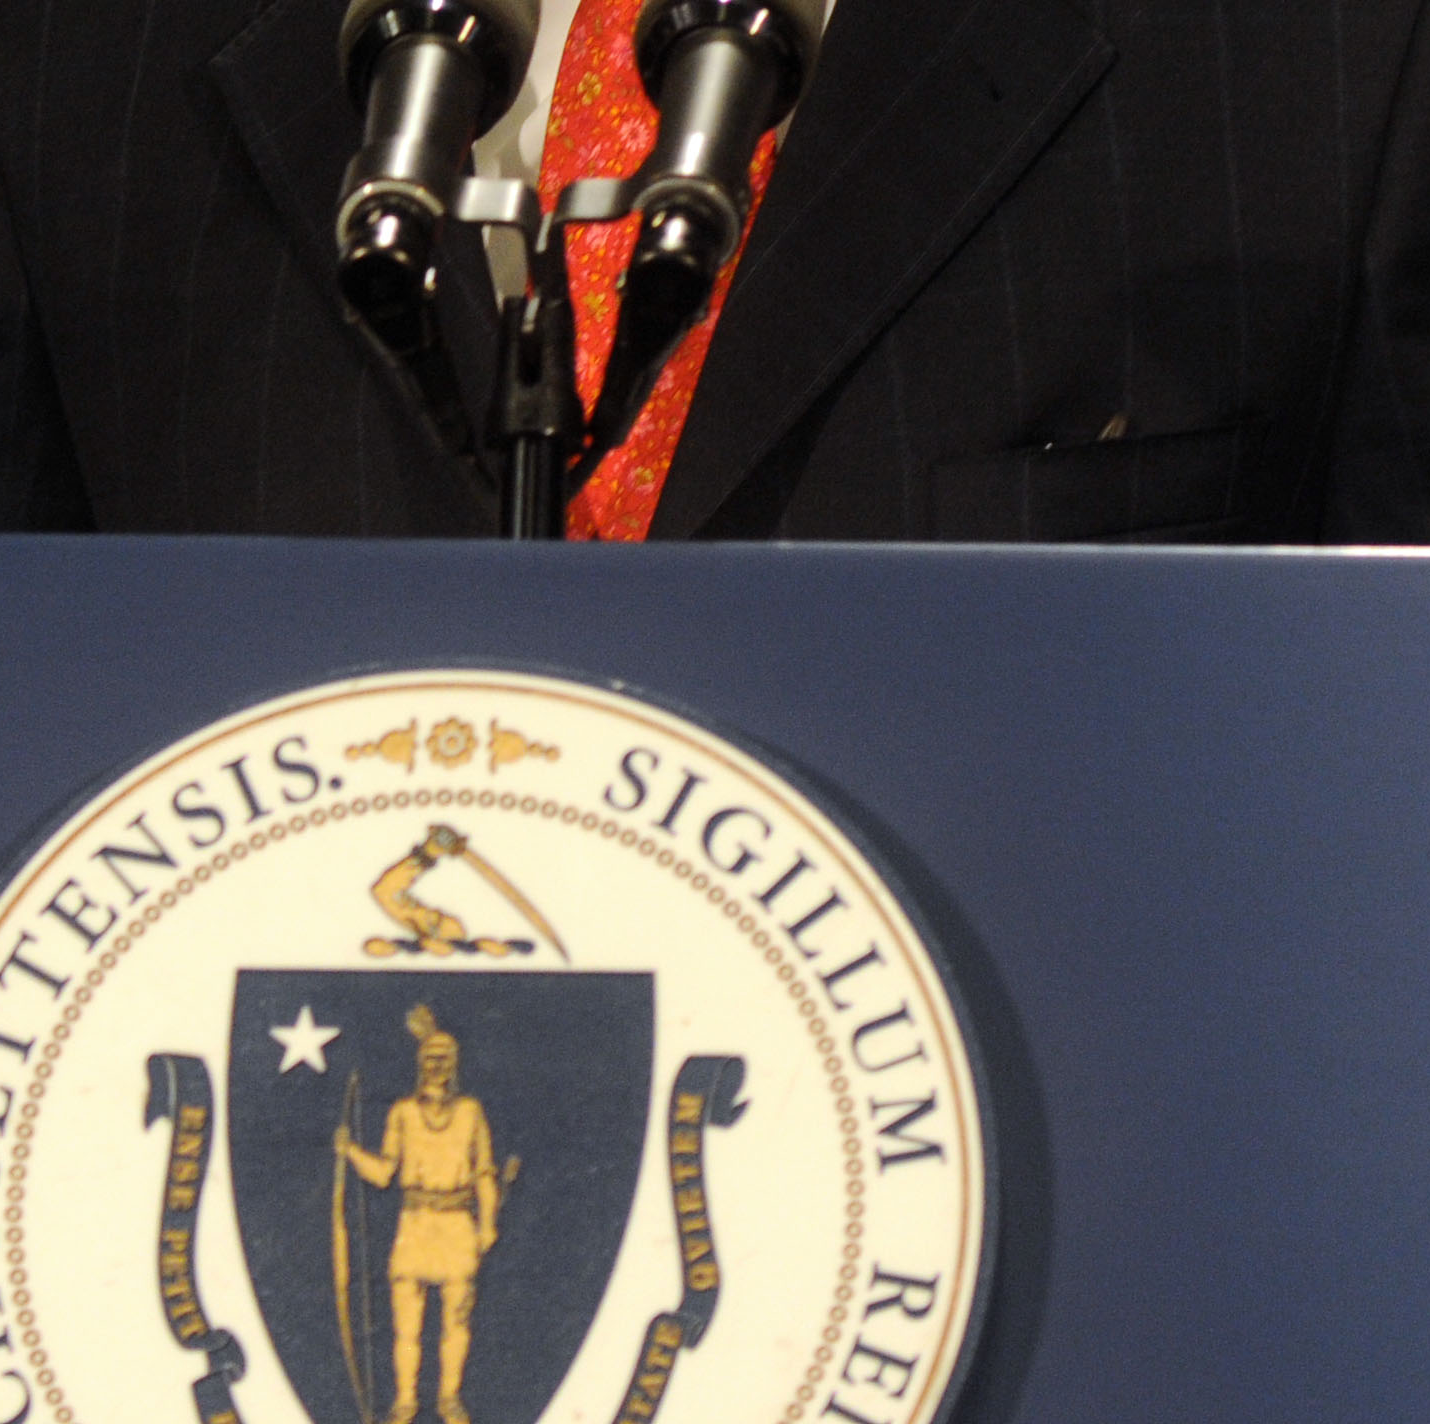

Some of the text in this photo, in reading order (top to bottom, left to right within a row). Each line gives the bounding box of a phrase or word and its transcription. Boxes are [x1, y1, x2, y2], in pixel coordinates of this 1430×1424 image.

[603, 747, 947, 1174] SIGILLUM
[163, 1106, 207, 1339] ENSE PETIT
[618, 1322, 682, 1424] TATE
